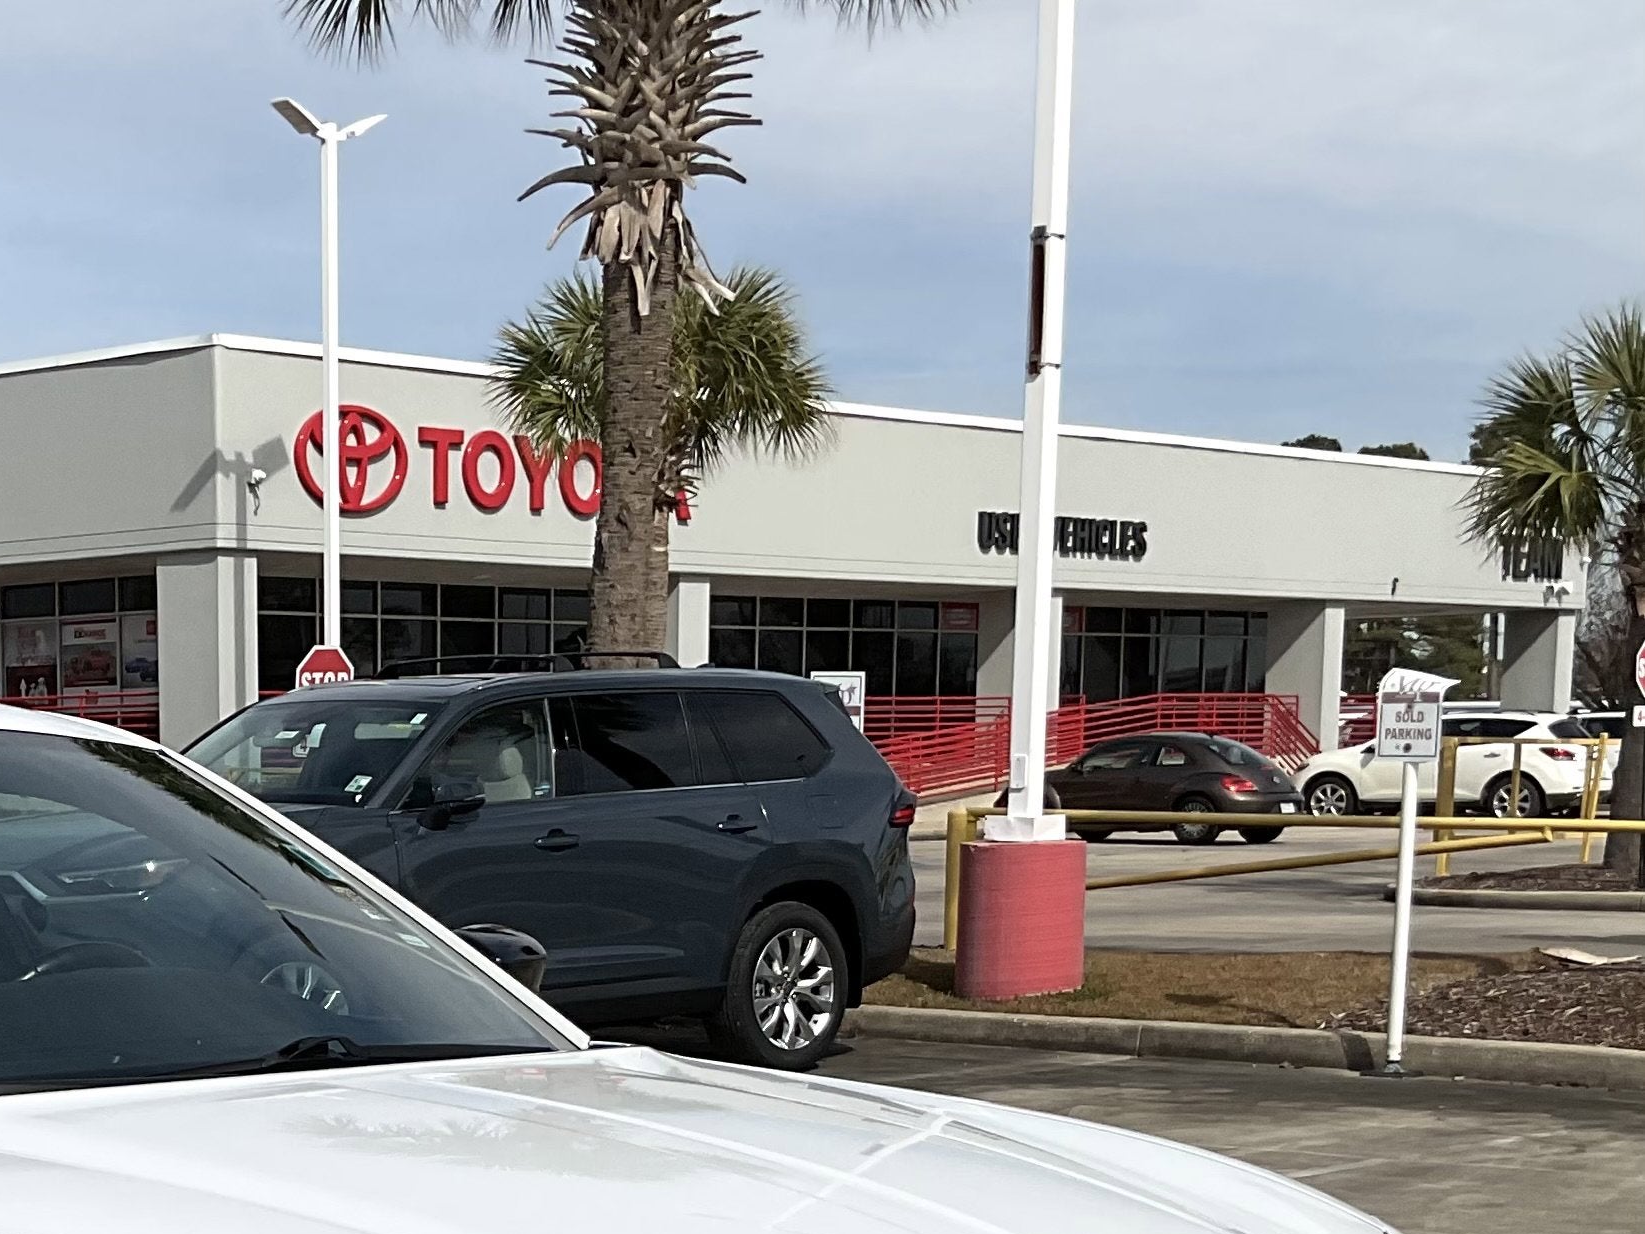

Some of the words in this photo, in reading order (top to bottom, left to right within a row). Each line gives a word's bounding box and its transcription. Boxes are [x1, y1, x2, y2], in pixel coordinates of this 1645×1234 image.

[418, 426, 692, 521] TOYO
[1395, 710, 1425, 723] SOLD
[1384, 727, 1433, 741] PARKING
